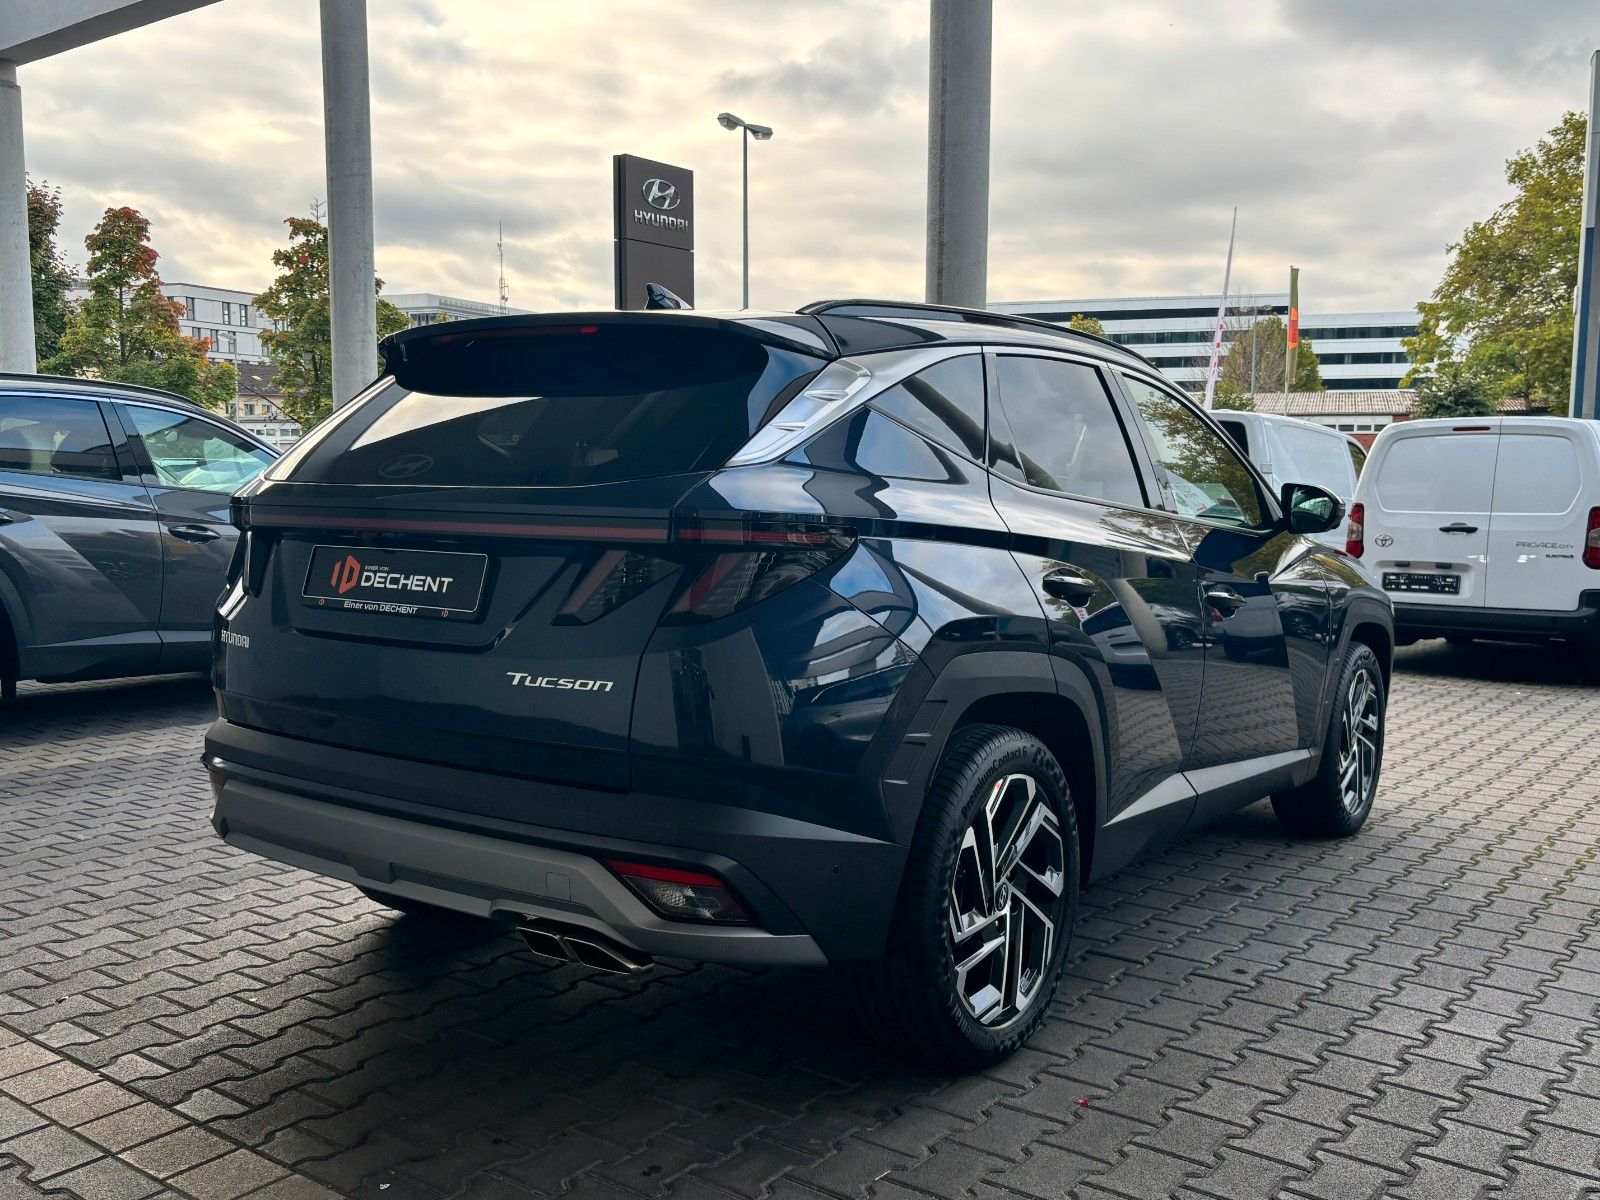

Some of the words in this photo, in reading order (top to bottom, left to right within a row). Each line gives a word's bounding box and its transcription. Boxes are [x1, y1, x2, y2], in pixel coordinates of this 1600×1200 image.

[634, 209, 688, 233] HYUNDAI
[361, 571, 453, 594] DECHENT
[344, 600, 363, 610] Einer
[364, 603, 379, 611] von
[379, 604, 418, 615] DECHENT
